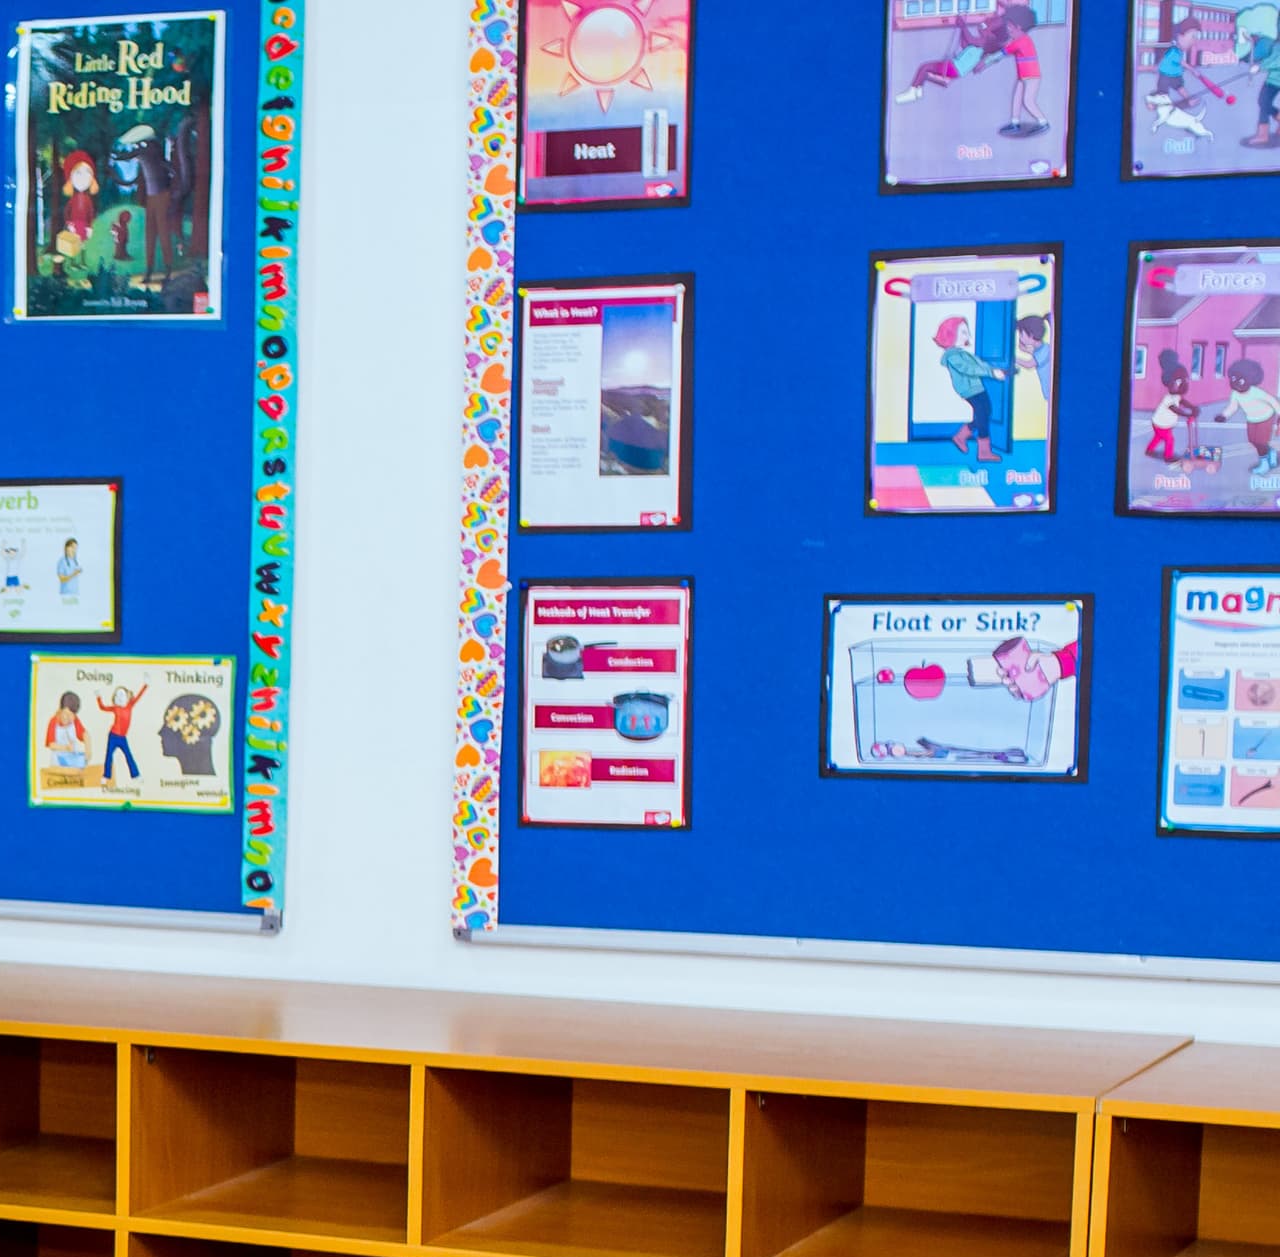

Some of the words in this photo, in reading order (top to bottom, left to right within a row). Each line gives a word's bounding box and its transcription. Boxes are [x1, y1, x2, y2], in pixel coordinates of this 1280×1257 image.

[74, 51, 115, 74] Little
[114, 39, 166, 77] Red
[46, 81, 124, 114] Riding
[126, 75, 192, 111] Hood
[573, 142, 617, 160] Heat
[957, 143, 993, 161] Push
[1163, 137, 1194, 155] Pull
[933, 277, 997, 297] Forces
[1199, 268, 1267, 290] Forces
[532, 307, 559, 319] What
[559, 307, 570, 319] is
[570, 305, 598, 318] Heat?
[959, 468, 989, 486] Pull
[1005, 468, 1043, 485] Push
[1153, 472, 1192, 490] Push
[536, 605, 576, 618] Methods
[577, 605, 587, 620] of
[588, 606, 611, 618] Heat
[612, 606, 652, 620] Transfer
[871, 611, 933, 632] Float
[940, 615, 967, 632] or
[975, 611, 1042, 632] Sink?
[607, 656, 654, 668] Conduction
[76, 669, 114, 685] Doing
[165, 671, 224, 688] Thinking
[608, 765, 650, 777] Radiation
[100, 784, 141, 797] Dancing
